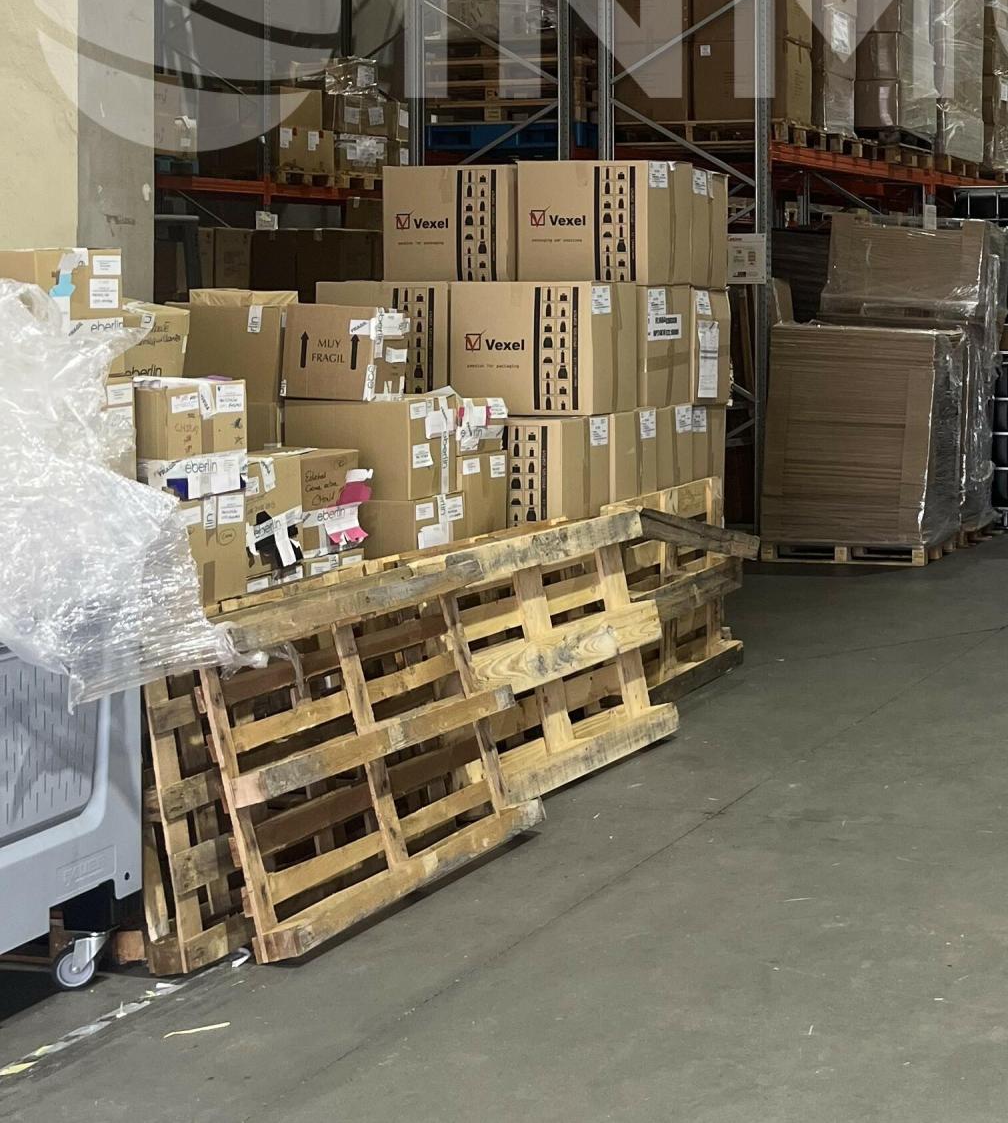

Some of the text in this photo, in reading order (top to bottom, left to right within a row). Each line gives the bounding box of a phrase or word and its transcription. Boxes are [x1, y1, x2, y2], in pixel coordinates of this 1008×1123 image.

[414, 218, 449, 229] Vexel
[549, 214, 586, 226] Vexel
[317, 339, 342, 349] MUY
[485, 339, 525, 351] Vexel
[311, 353, 345, 364] FRAGIL
[184, 458, 218, 475] eberlin
